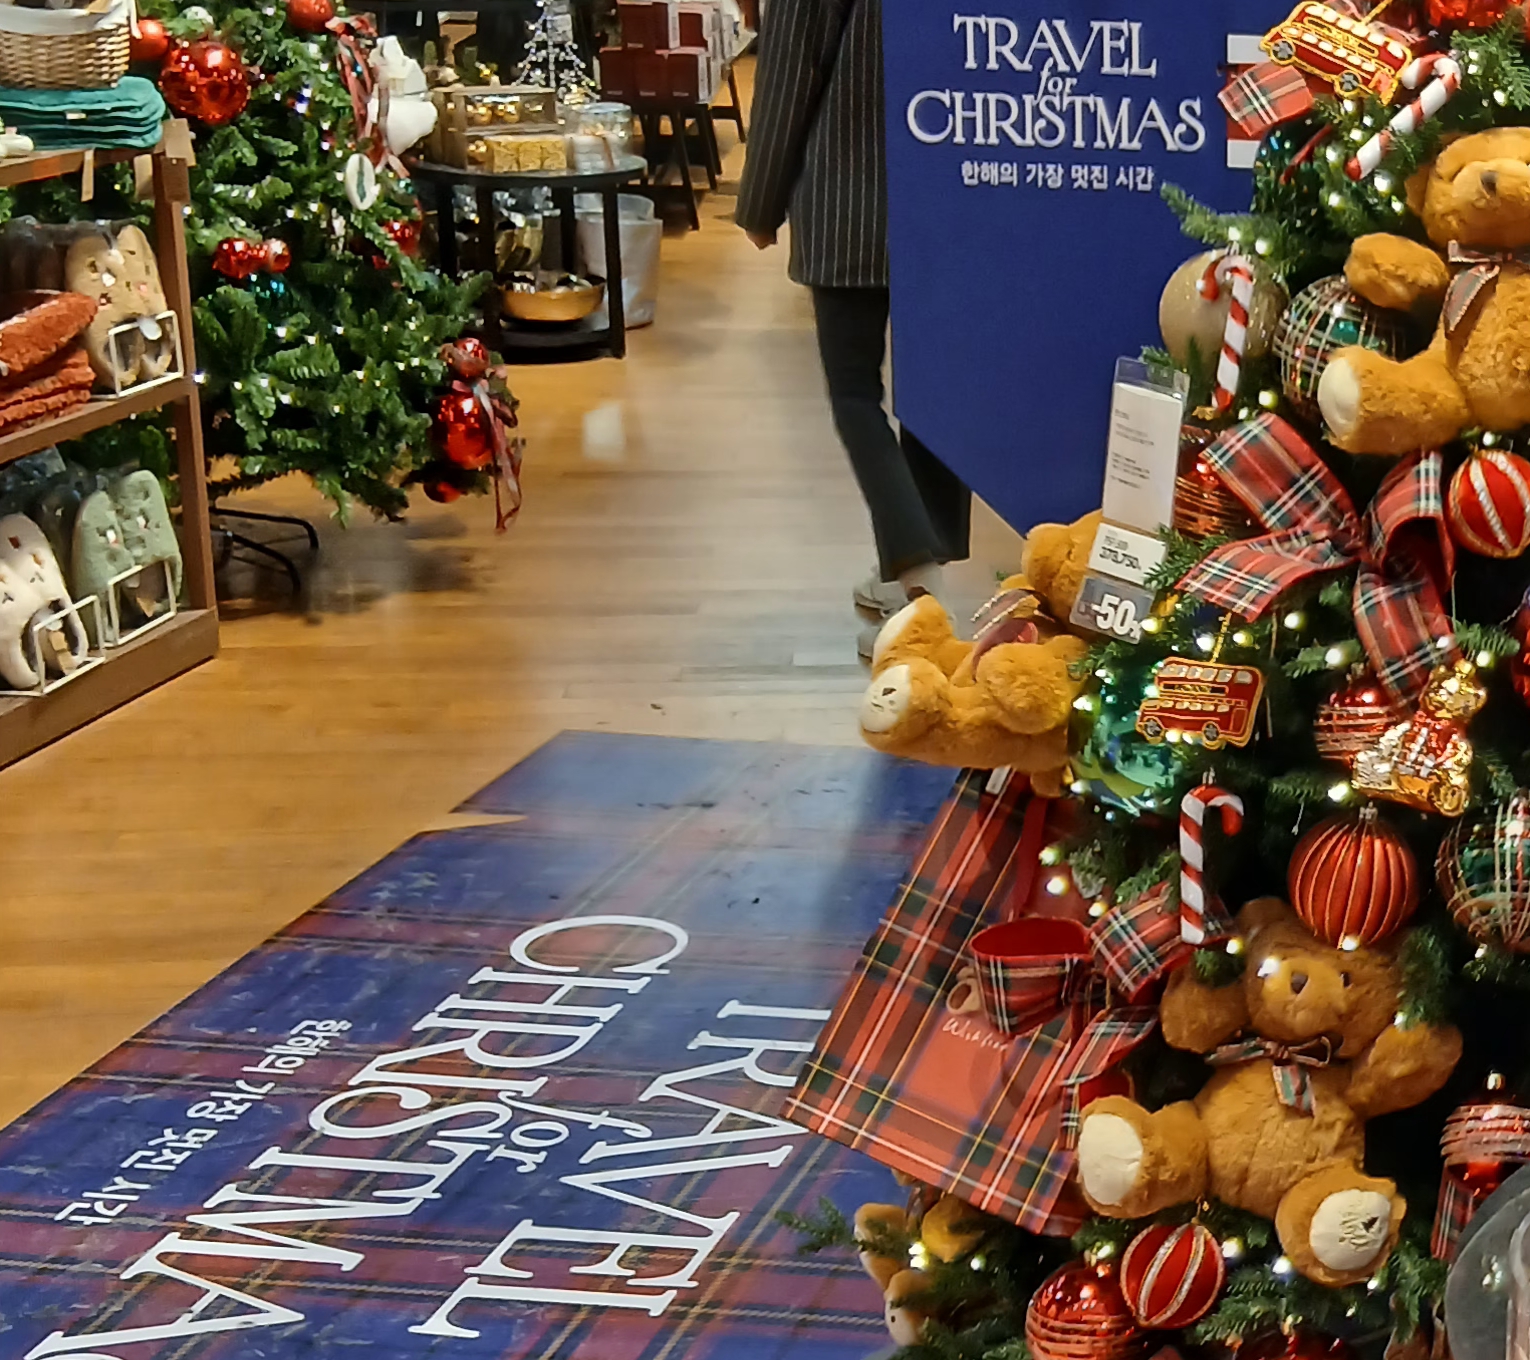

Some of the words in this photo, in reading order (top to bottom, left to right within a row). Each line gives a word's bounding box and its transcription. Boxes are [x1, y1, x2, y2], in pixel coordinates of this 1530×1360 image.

[954, 14, 1156, 78] TRAVEL
[1033, 57, 1077, 104] for
[907, 89, 1206, 152] CHRISTMAS
[961, 161, 1018, 187] 한해의
[1026, 163, 1064, 188] 가장
[1071, 164, 1108, 189] 멋진
[1115, 166, 1154, 191] 시간
[241, 1019, 353, 1075] 한해의
[186, 1079, 275, 1122] 가장
[120, 1127, 218, 1171] 멋진
[488, 1089, 653, 1173] for
[54, 1176, 151, 1226] 시간
